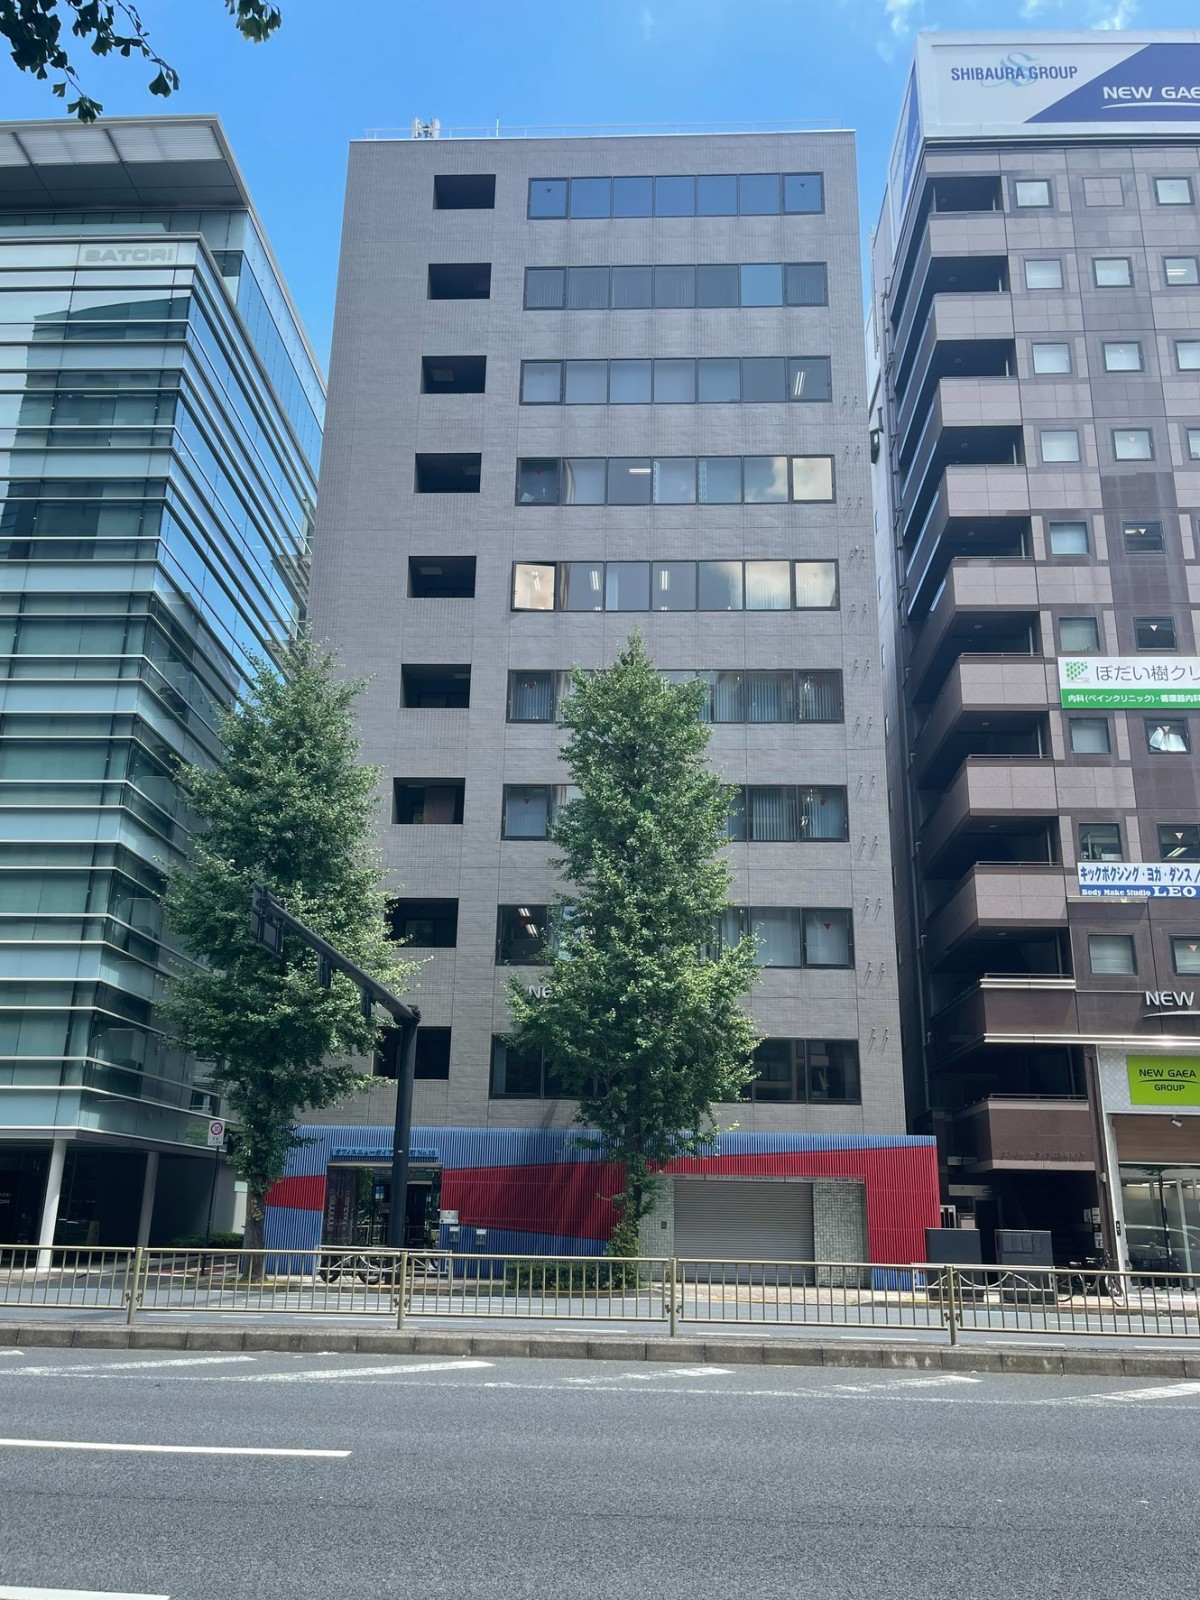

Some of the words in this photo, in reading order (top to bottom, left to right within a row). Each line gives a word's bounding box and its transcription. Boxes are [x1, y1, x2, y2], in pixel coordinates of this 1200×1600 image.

[950, 66, 1025, 81] SHIBAURA
[1028, 65, 1078, 79] GROUP
[1103, 86, 1153, 99] NEW
[1161, 86, 1200, 99] GAE
[84, 248, 174, 262] SATORI
[1152, 886, 1196, 897] LEO
[528, 984, 553, 999] NE
[1145, 991, 1194, 1006] NEW
[1139, 1068, 1163, 1078] NEW
[1167, 1069, 1196, 1078] GAEA
